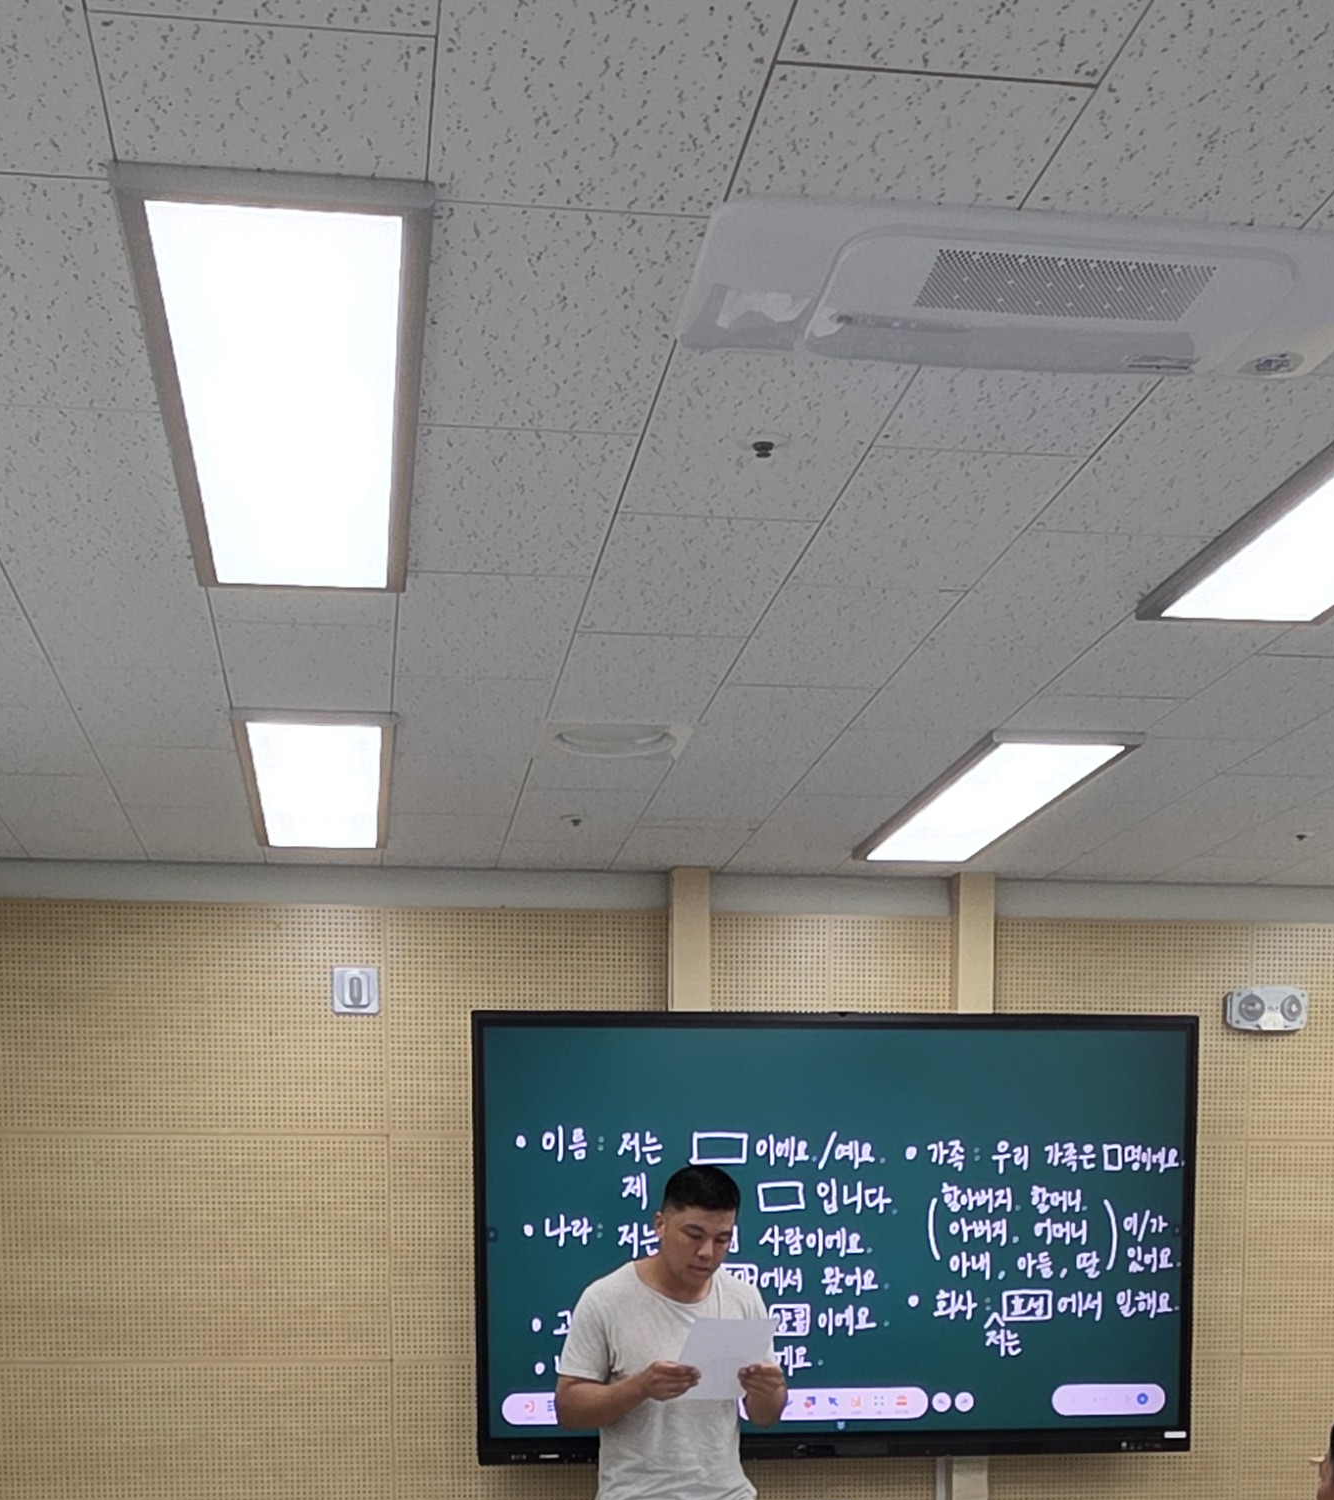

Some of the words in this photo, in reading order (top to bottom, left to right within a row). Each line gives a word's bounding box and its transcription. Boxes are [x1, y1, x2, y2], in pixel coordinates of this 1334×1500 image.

[617, 1131, 663, 1165] 저는
[991, 1140, 1029, 1175] 우리
[1044, 1142, 1097, 1173] 가족은
[617, 1222, 660, 1259] 저는
[1034, 1218, 1088, 1246] 어머니
[1075, 1250, 1101, 1279] 딸
[985, 1328, 1023, 1358] 저는
